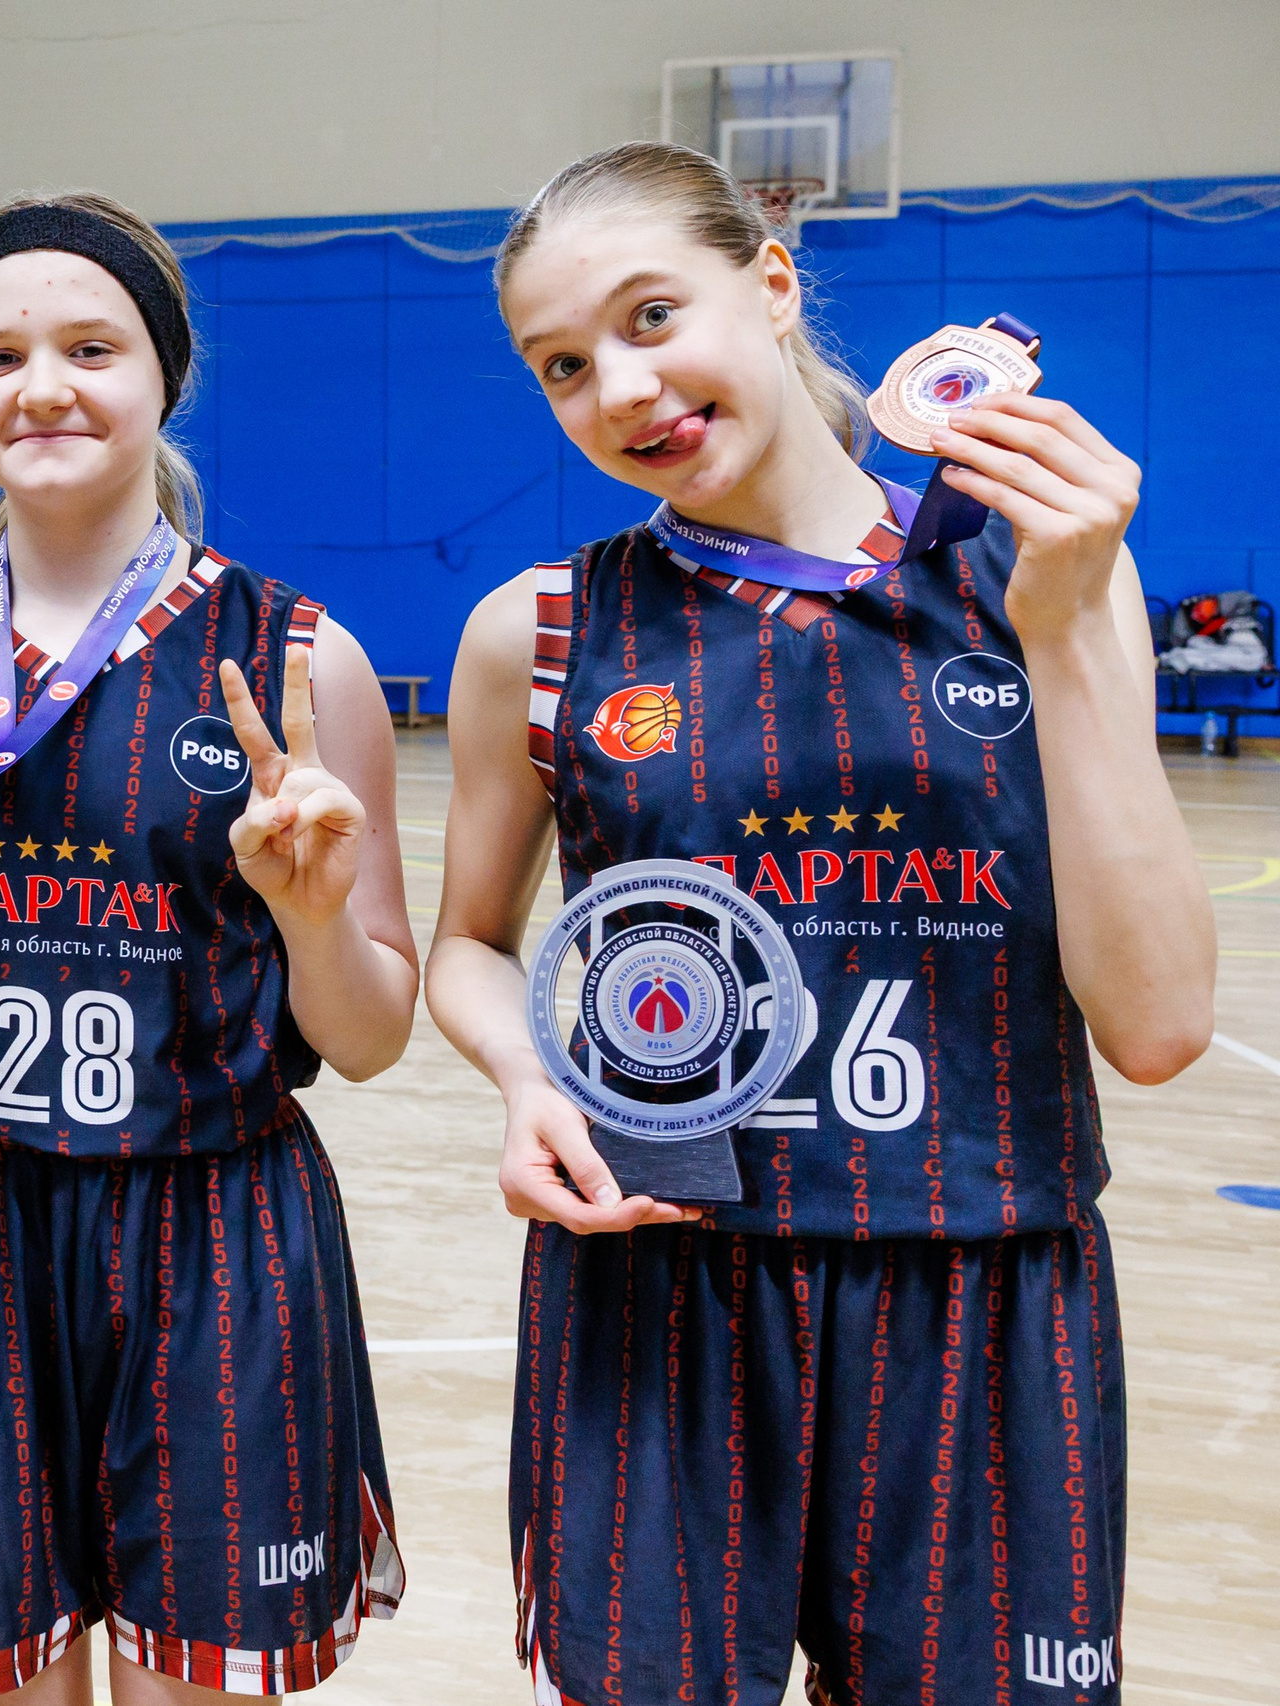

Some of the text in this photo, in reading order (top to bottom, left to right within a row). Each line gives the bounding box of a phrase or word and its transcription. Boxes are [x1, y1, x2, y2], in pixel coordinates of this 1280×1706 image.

[949, 333, 1027, 379] ТРЕТЬЕ МЕСТО
[101, 571, 138, 620] ОБЛАСТИ
[945, 681, 1021, 708] РФБ
[180, 739, 242, 772] РФБ
[560, 897, 596, 932] ИГРОК
[594, 876, 711, 904] СИМВОЛИЧЕСКОЙ
[711, 889, 764, 936] ПЯТЕРКИ
[792, 915, 881, 938] область
[917, 916, 1004, 941] Видное
[16, 934, 91, 956] область
[119, 940, 183, 964] Видное
[595, 928, 660, 971] МОСКОВСКОЙ
[664, 930, 713, 958] ОБЛАСТИ
[711, 956, 726, 973] ПО
[585, 969, 602, 1041] ПЕРВЕНСТВО
[612, 954, 706, 1034] МОСКОВСКАЯ ОБЛАСТНАЯ ФЕДЕРАЦИЯ БАСКЕТБОЛА
[715, 971, 736, 1046] БАСКЕТБОЛУ
[618, 1057, 702, 1078] СЕЗОН 2025/26
[560, 1073, 605, 1113] ДЕВУШКИ
[603, 1106, 619, 1120] ДО
[619, 1114, 633, 1125] 15
[632, 1118, 654, 1129] ЛЕТ
[258, 1532, 325, 1588] ШФК
[1023, 1631, 1117, 1690] ШФК
